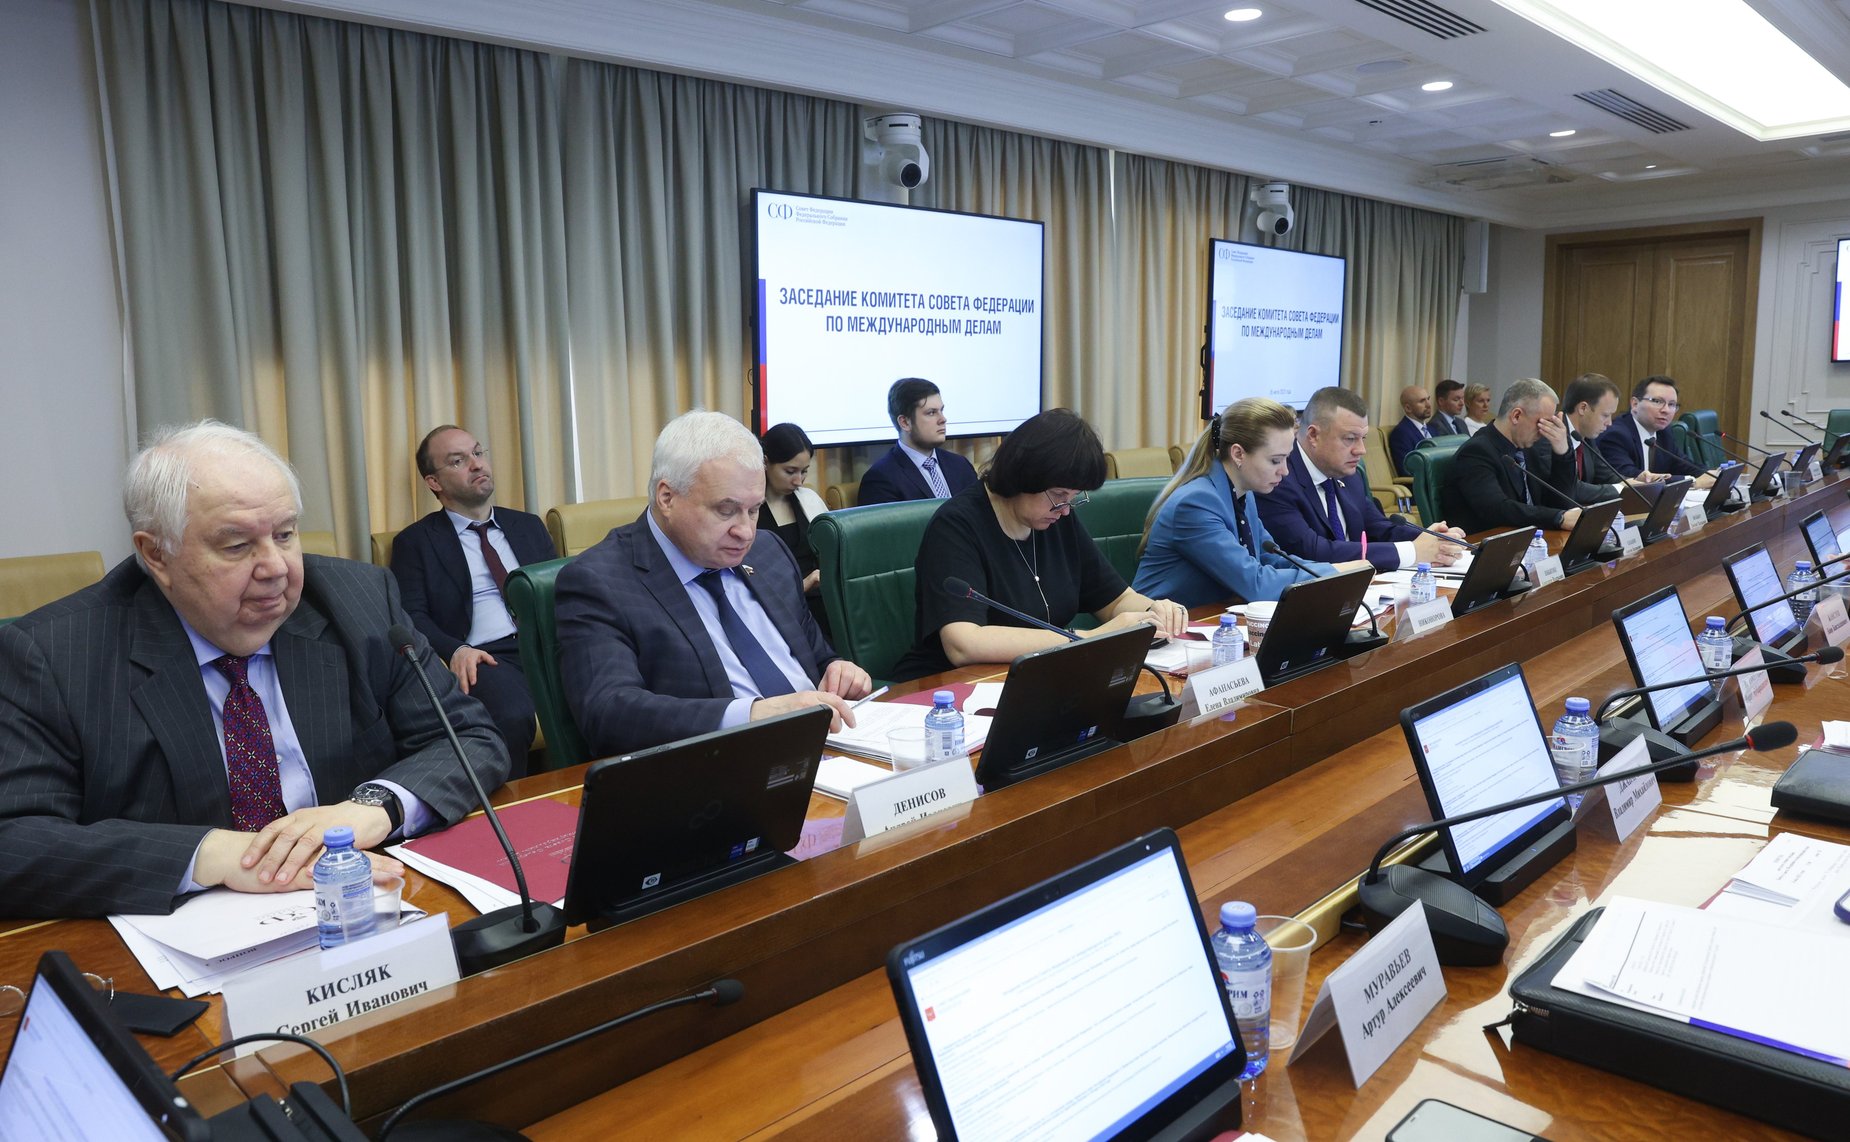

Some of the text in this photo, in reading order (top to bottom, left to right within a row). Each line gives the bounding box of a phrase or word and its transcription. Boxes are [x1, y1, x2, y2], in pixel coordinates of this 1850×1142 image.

[768, 202, 793, 220] СФ
[779, 287, 1035, 315] ЗАСЕДАНИЕ КОМИТЕТА СОВЕТА ФЕДЕРАЦИИ
[826, 315, 1002, 336] ПО МЕЖДУНАРОДНЫМ ДЕЛАМ
[1221, 305, 1340, 325] ЗАСЕДАНИЕ КОМИТЕТА СОВЕТА ФЕДЕРАЦИИ
[1241, 325, 1323, 340] ПО МЕЖДУНАРОДНЫМ ДЕЛАМ
[1209, 677, 1250, 697] АФАНАСЬЕВА
[1205, 700, 1222, 713] Елена
[894, 787, 947, 816] ДЕНИСОВ
[305, 963, 392, 1006] КИСЛЯК
[1363, 948, 1412, 1004] МУРАВЬЕВ
[346, 981, 428, 1018] Иванович
[1361, 966, 1427, 1040] Артур Алексеевич
